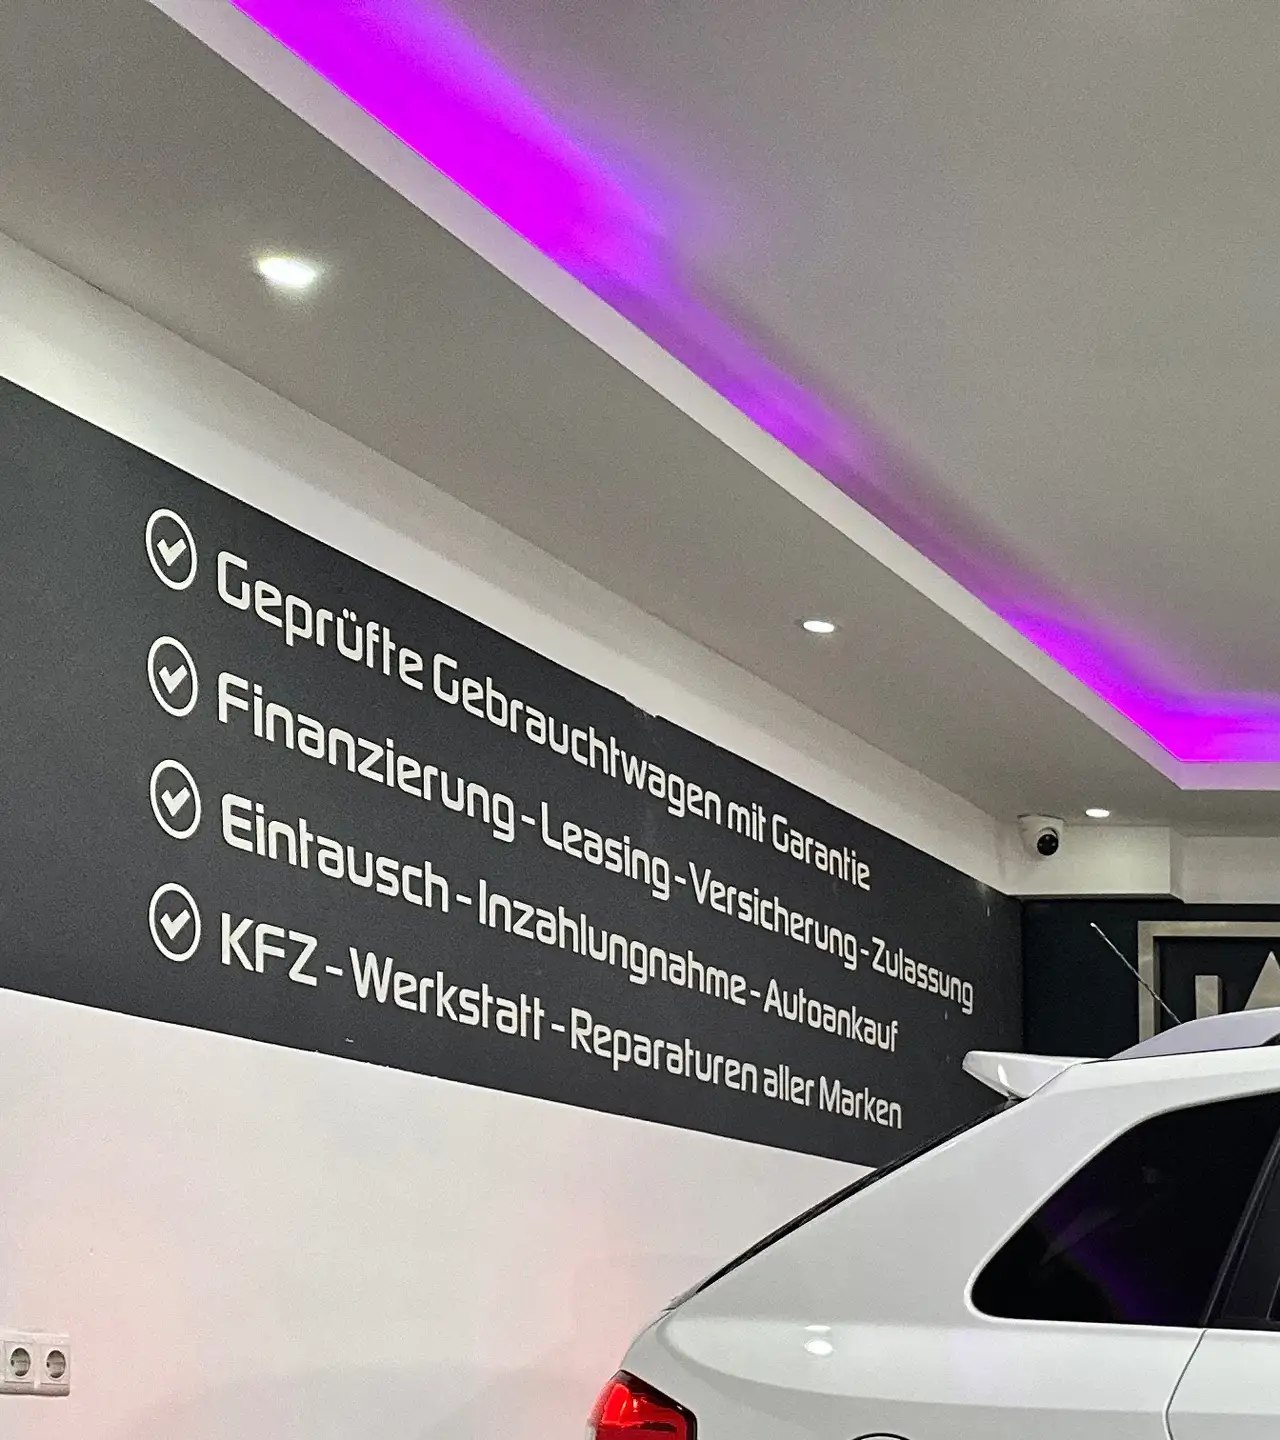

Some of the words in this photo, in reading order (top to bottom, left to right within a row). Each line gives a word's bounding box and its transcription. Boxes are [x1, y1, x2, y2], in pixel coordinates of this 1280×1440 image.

[217, 550, 424, 691] Geprüfte
[433, 653, 722, 825] Gebrauchtwagen
[727, 801, 767, 843] mit
[772, 813, 871, 891] Garantie
[763, 1064, 815, 1107] aller
[819, 1075, 902, 1130] Marken
